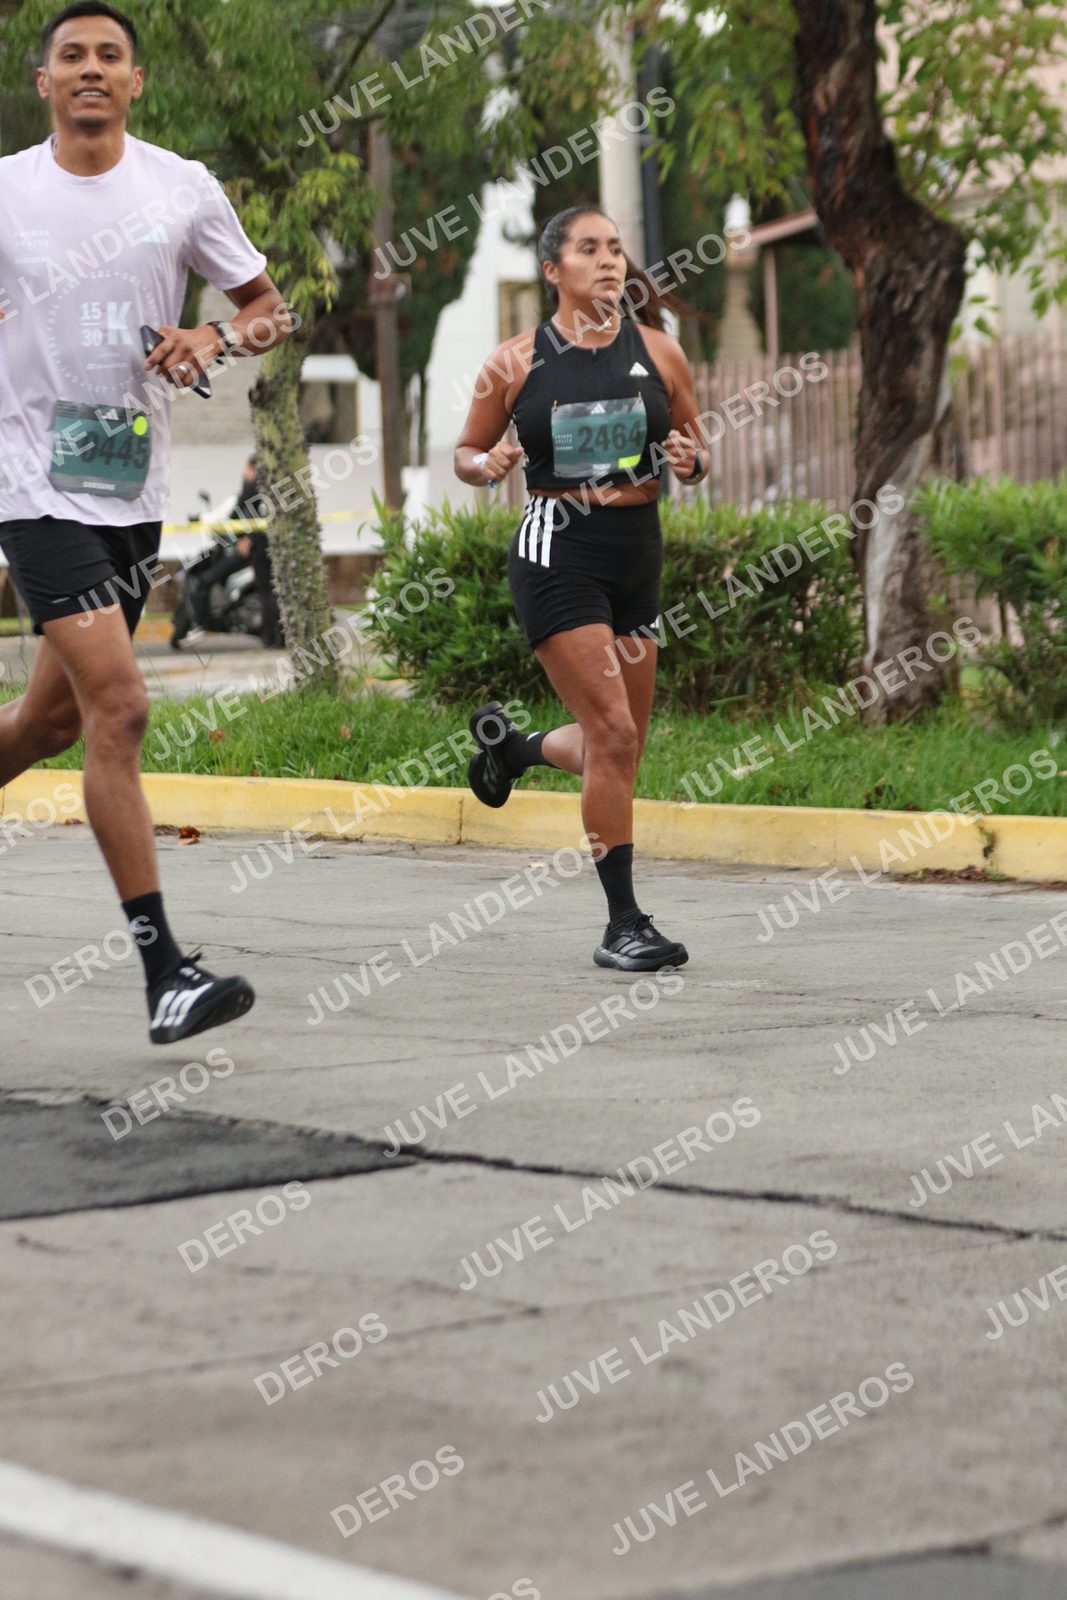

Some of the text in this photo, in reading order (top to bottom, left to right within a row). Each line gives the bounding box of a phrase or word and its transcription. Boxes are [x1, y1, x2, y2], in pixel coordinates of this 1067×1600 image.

[80, 302, 102, 320] 15
[107, 301, 133, 345] K
[80, 328, 102, 347] 30
[577, 420, 644, 454] 2464
